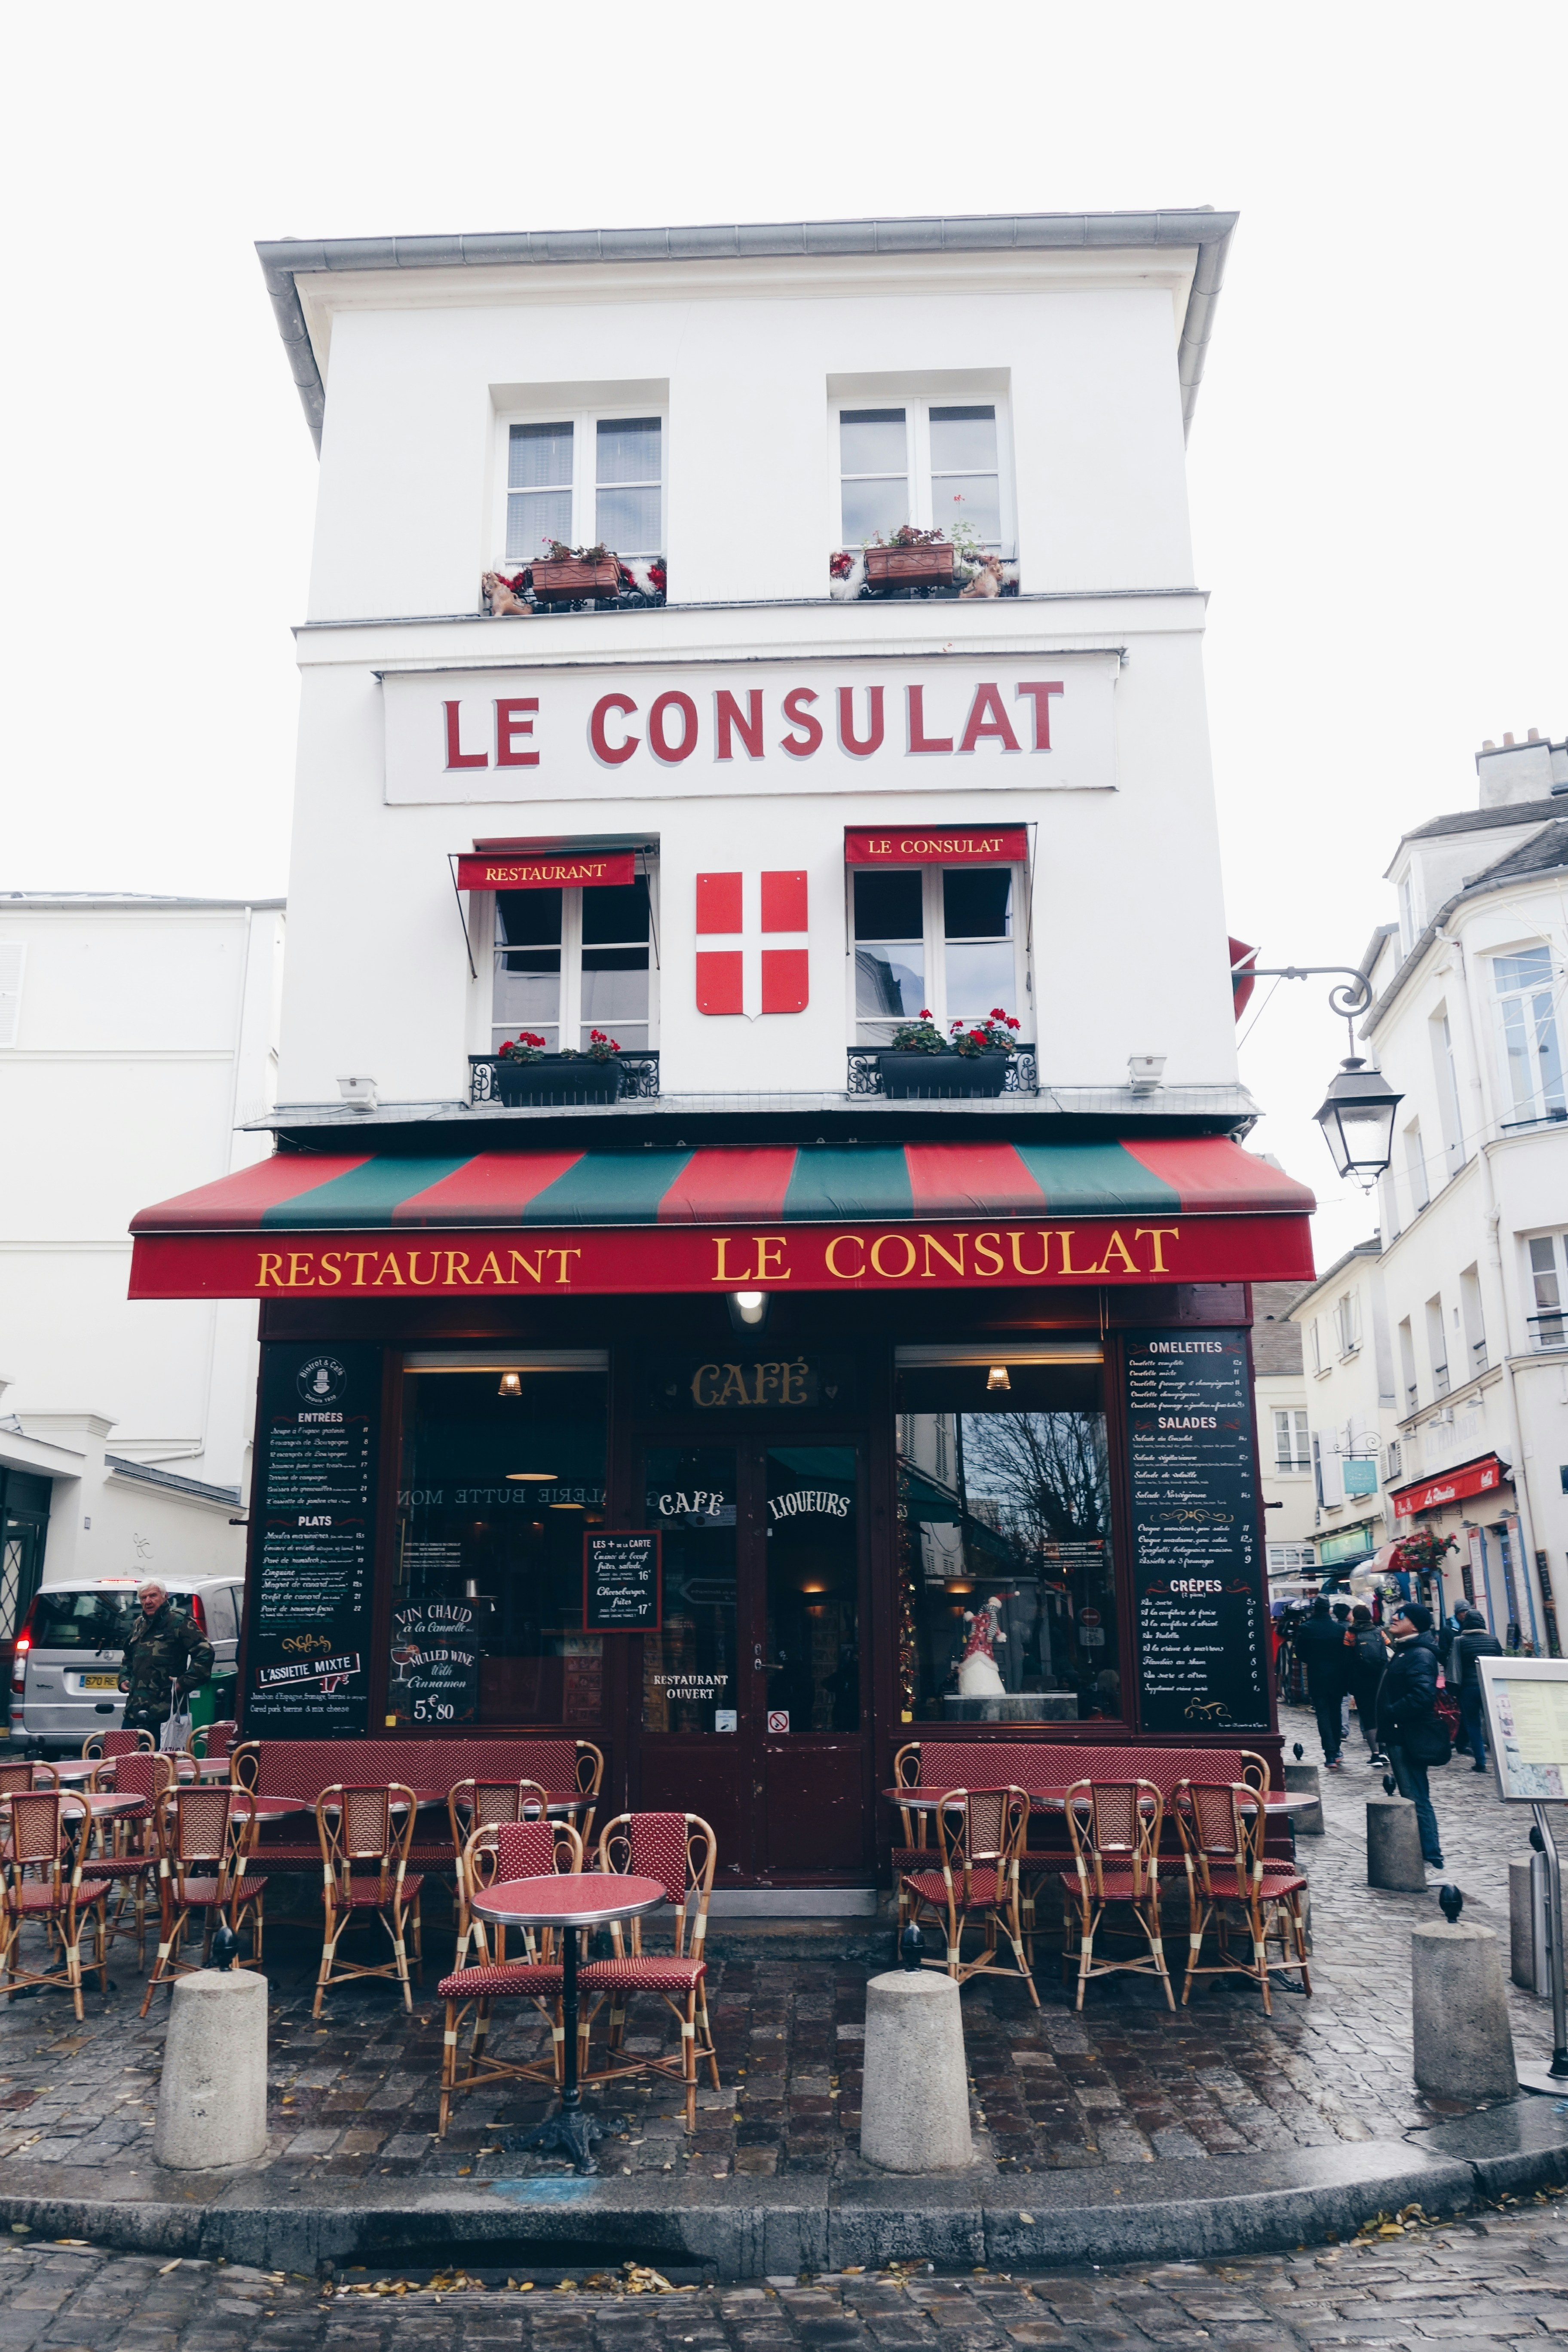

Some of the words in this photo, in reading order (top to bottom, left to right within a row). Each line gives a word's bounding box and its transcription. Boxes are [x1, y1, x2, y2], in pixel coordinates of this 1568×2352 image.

[441, 697, 541, 772] LE
[587, 680, 1065, 768] CONSULAT
[868, 840, 891, 854] LE
[900, 839, 1004, 854] CONSULAT
[485, 864, 606, 881] RESTAURANT
[712, 1237, 791, 1281] LE
[825, 1227, 1179, 1278] CONSULAT
[255, 1248, 581, 1287] RESTAURANT
[1149, 1341, 1222, 1353] OMELETTES
[299, 1359, 322, 1378] Bistrot
[330, 1361, 344, 1376] Café
[690, 1356, 810, 1406] CAFÉ
[298, 1412, 343, 1422] ENTRÉES
[1158, 1417, 1217, 1429] SALADES
[658, 1490, 725, 1517] CAFÉ
[768, 1490, 851, 1519] LIQUEURS
[298, 1516, 332, 1526] PLATS
[1244, 1555, 1252, 1564] 9
[1170, 1578, 1222, 1592] CRÊPES
[395, 1606, 422, 1624] VIN
[428, 1605, 472, 1623] CHAUD
[403, 1623, 412, 1633] à
[414, 1622, 426, 1632] la
[427, 1622, 466, 1632] Cannelle
[409, 1650, 448, 1667] MULLED
[451, 1650, 475, 1667] WINE
[260, 1664, 310, 1682] L'ASSIETTE
[315, 1657, 351, 1672] MIXTE
[405, 1676, 467, 1688] Cinnamon
[654, 1675, 729, 1685] RESTAURANT
[667, 1689, 714, 1699] OUVERT
